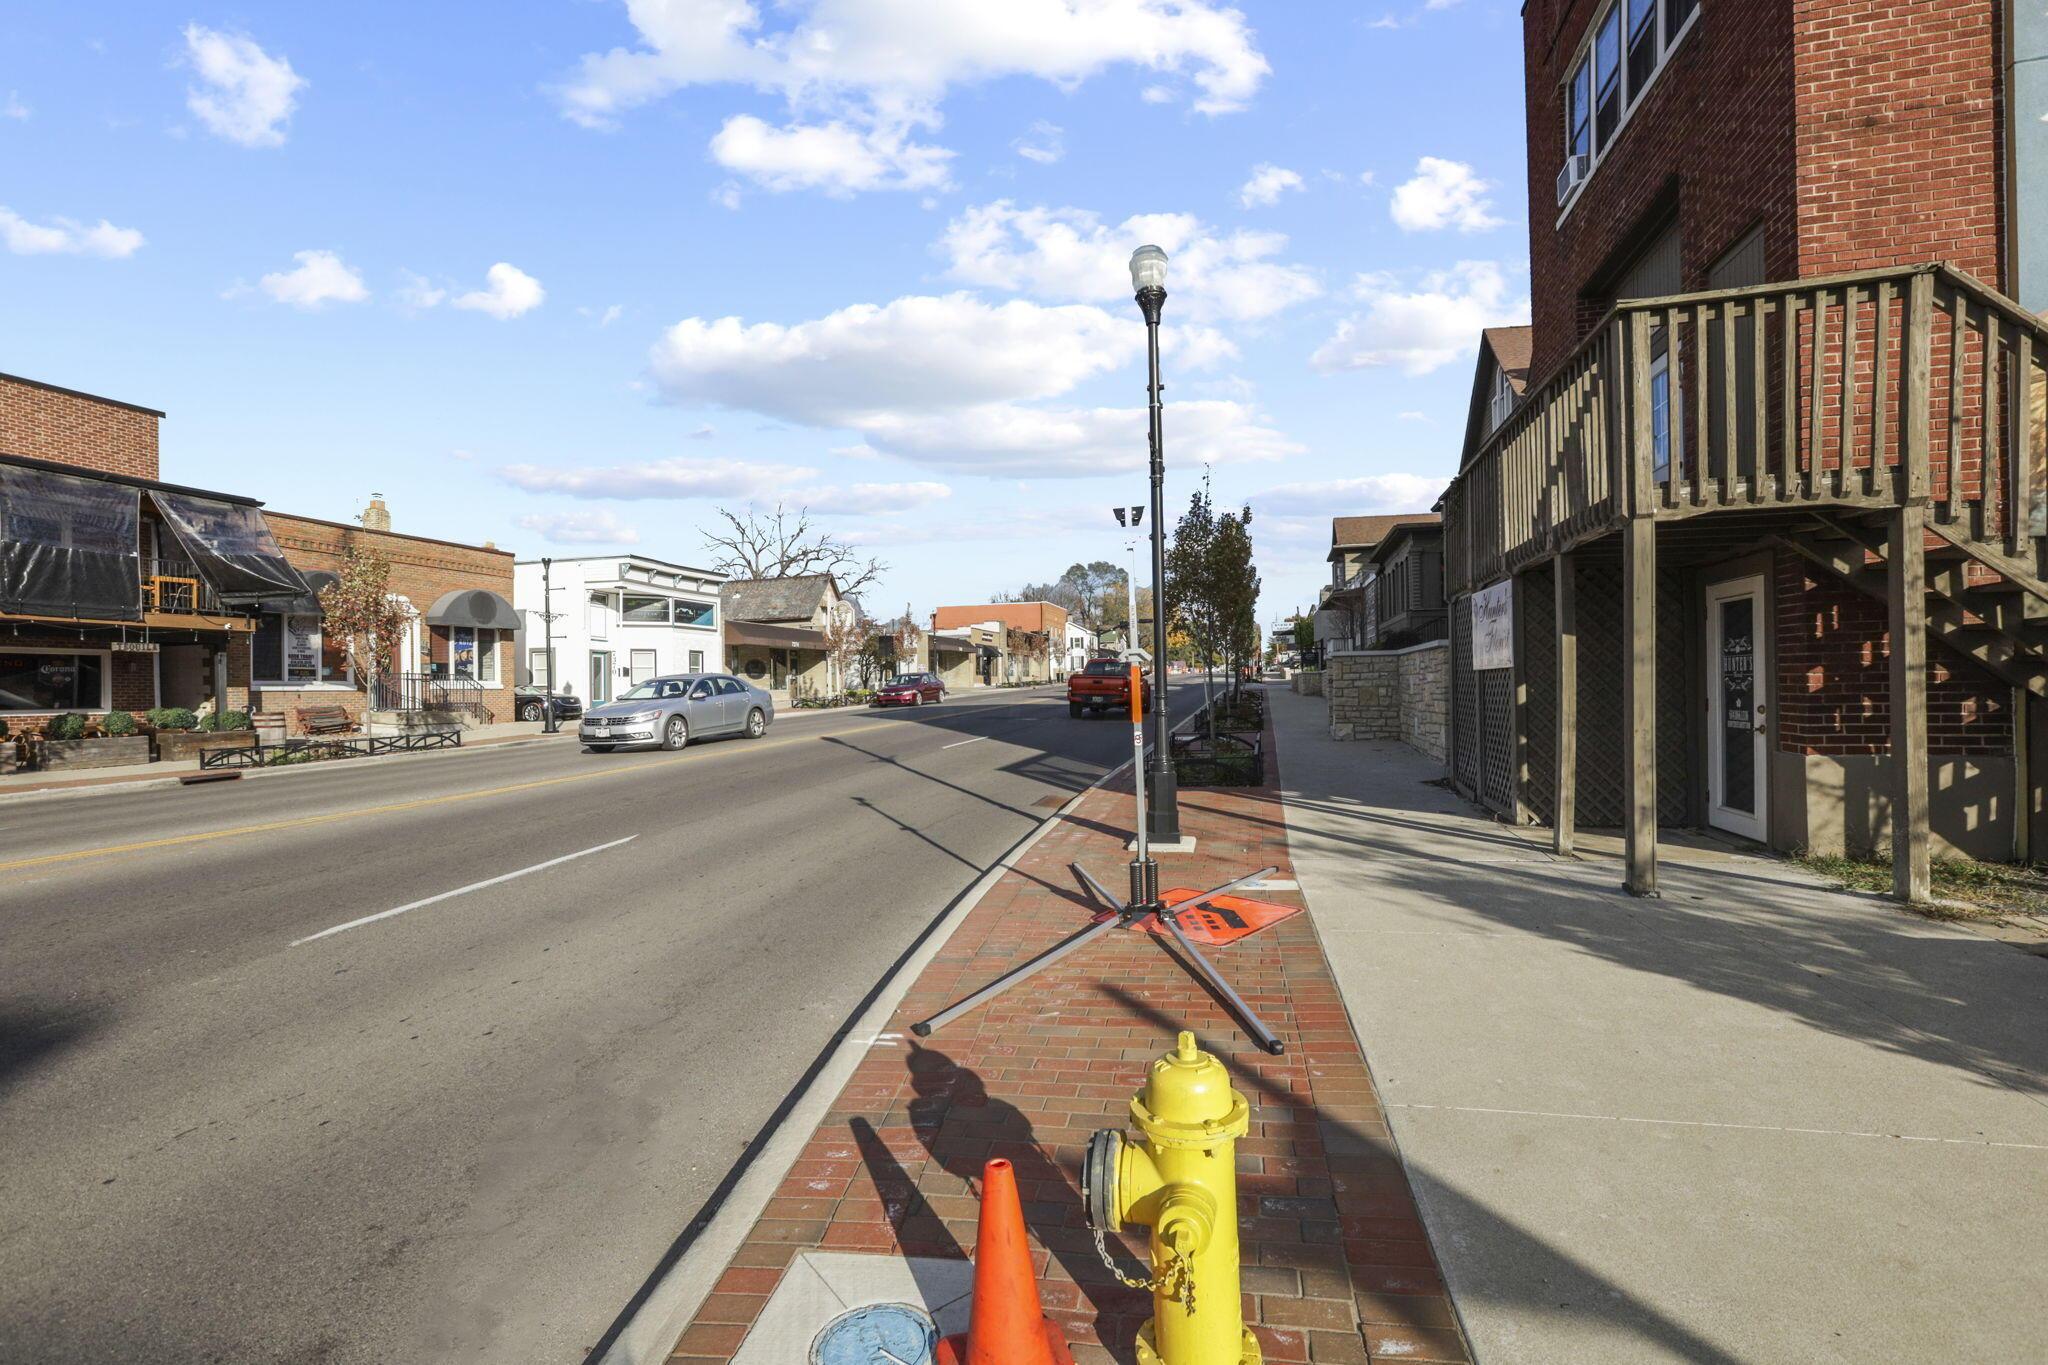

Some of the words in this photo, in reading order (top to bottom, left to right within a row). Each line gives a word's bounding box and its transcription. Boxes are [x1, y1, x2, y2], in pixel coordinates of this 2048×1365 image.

[116, 642, 158, 651] TEQUILA
[1724, 656, 1753, 671] HUNTER'S
[40, 664, 77, 674] Corona
